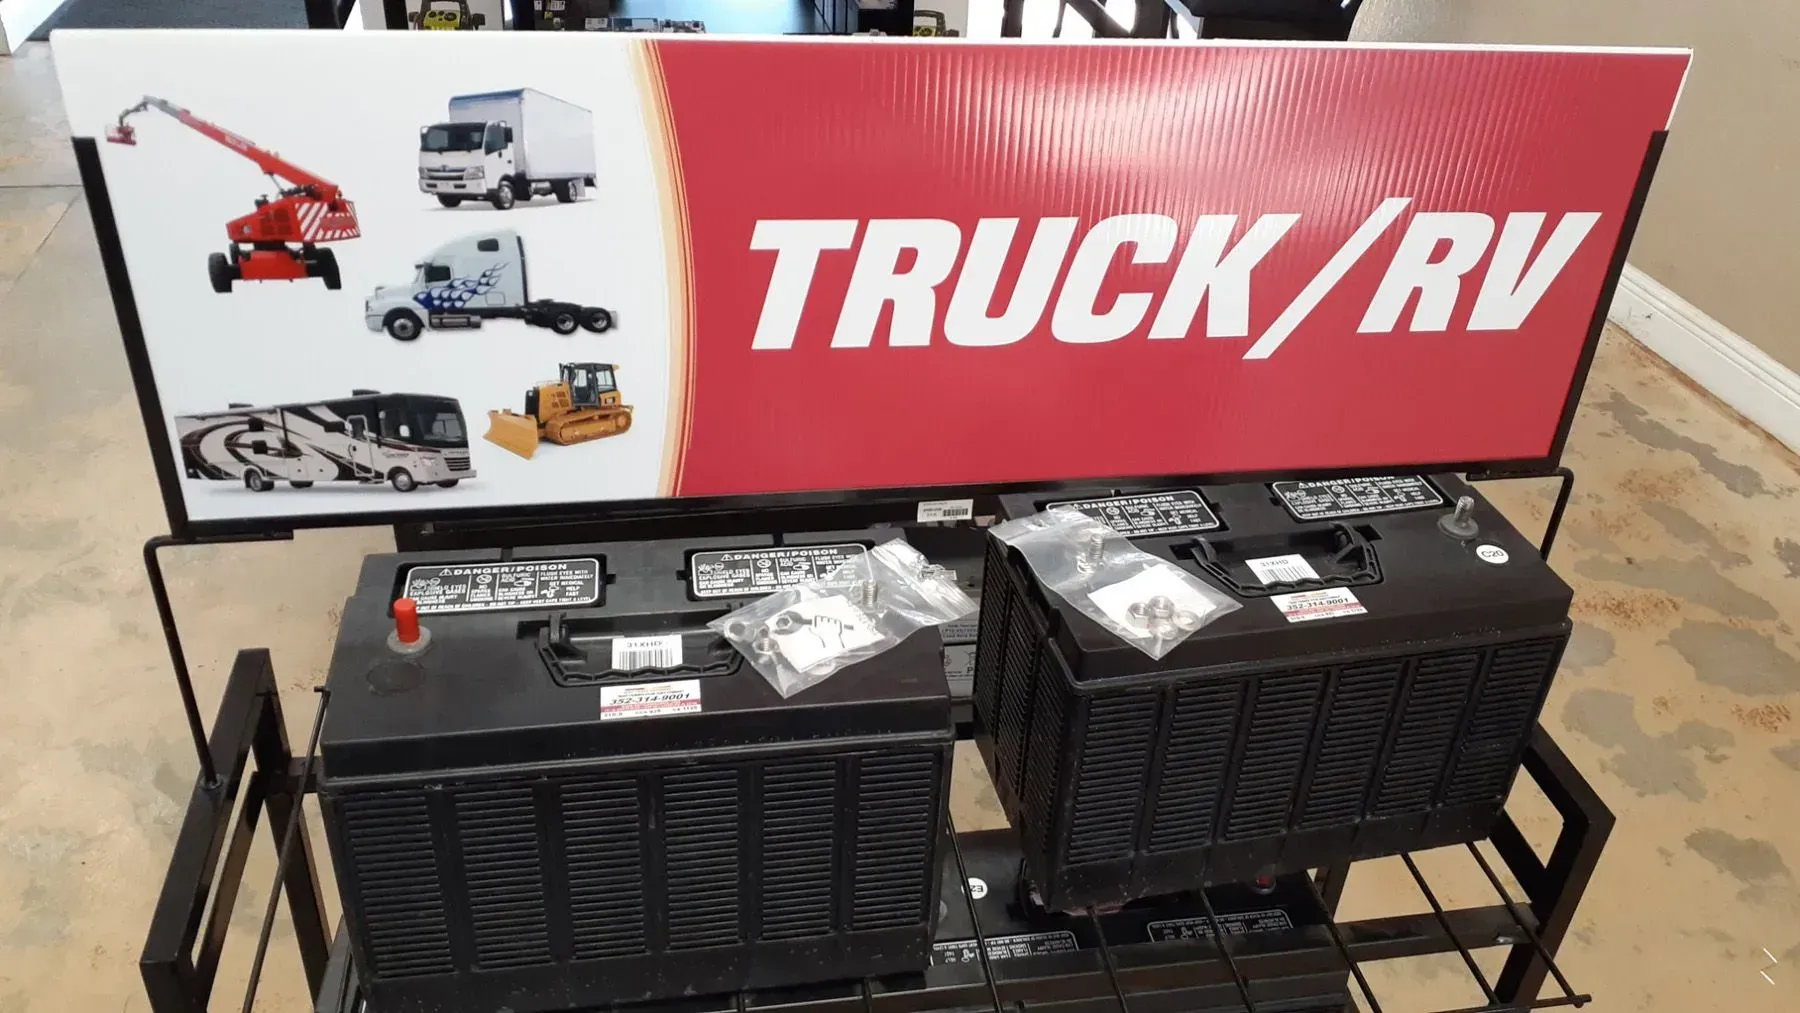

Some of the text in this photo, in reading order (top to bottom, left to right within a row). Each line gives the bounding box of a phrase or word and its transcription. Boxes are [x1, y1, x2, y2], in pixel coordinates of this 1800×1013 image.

[750, 197, 1602, 360] TRUCK/RV
[1083, 495, 1174, 509] DANGER/POISON
[734, 549, 838, 560] DANGER/POISON
[1481, 550, 1504, 558] C20
[454, 563, 567, 576] DANGER/POISON
[1287, 597, 1349, 611] 352-314-9001
[610, 692, 690, 705] 352-314-9001
[969, 885, 984, 893] E2
